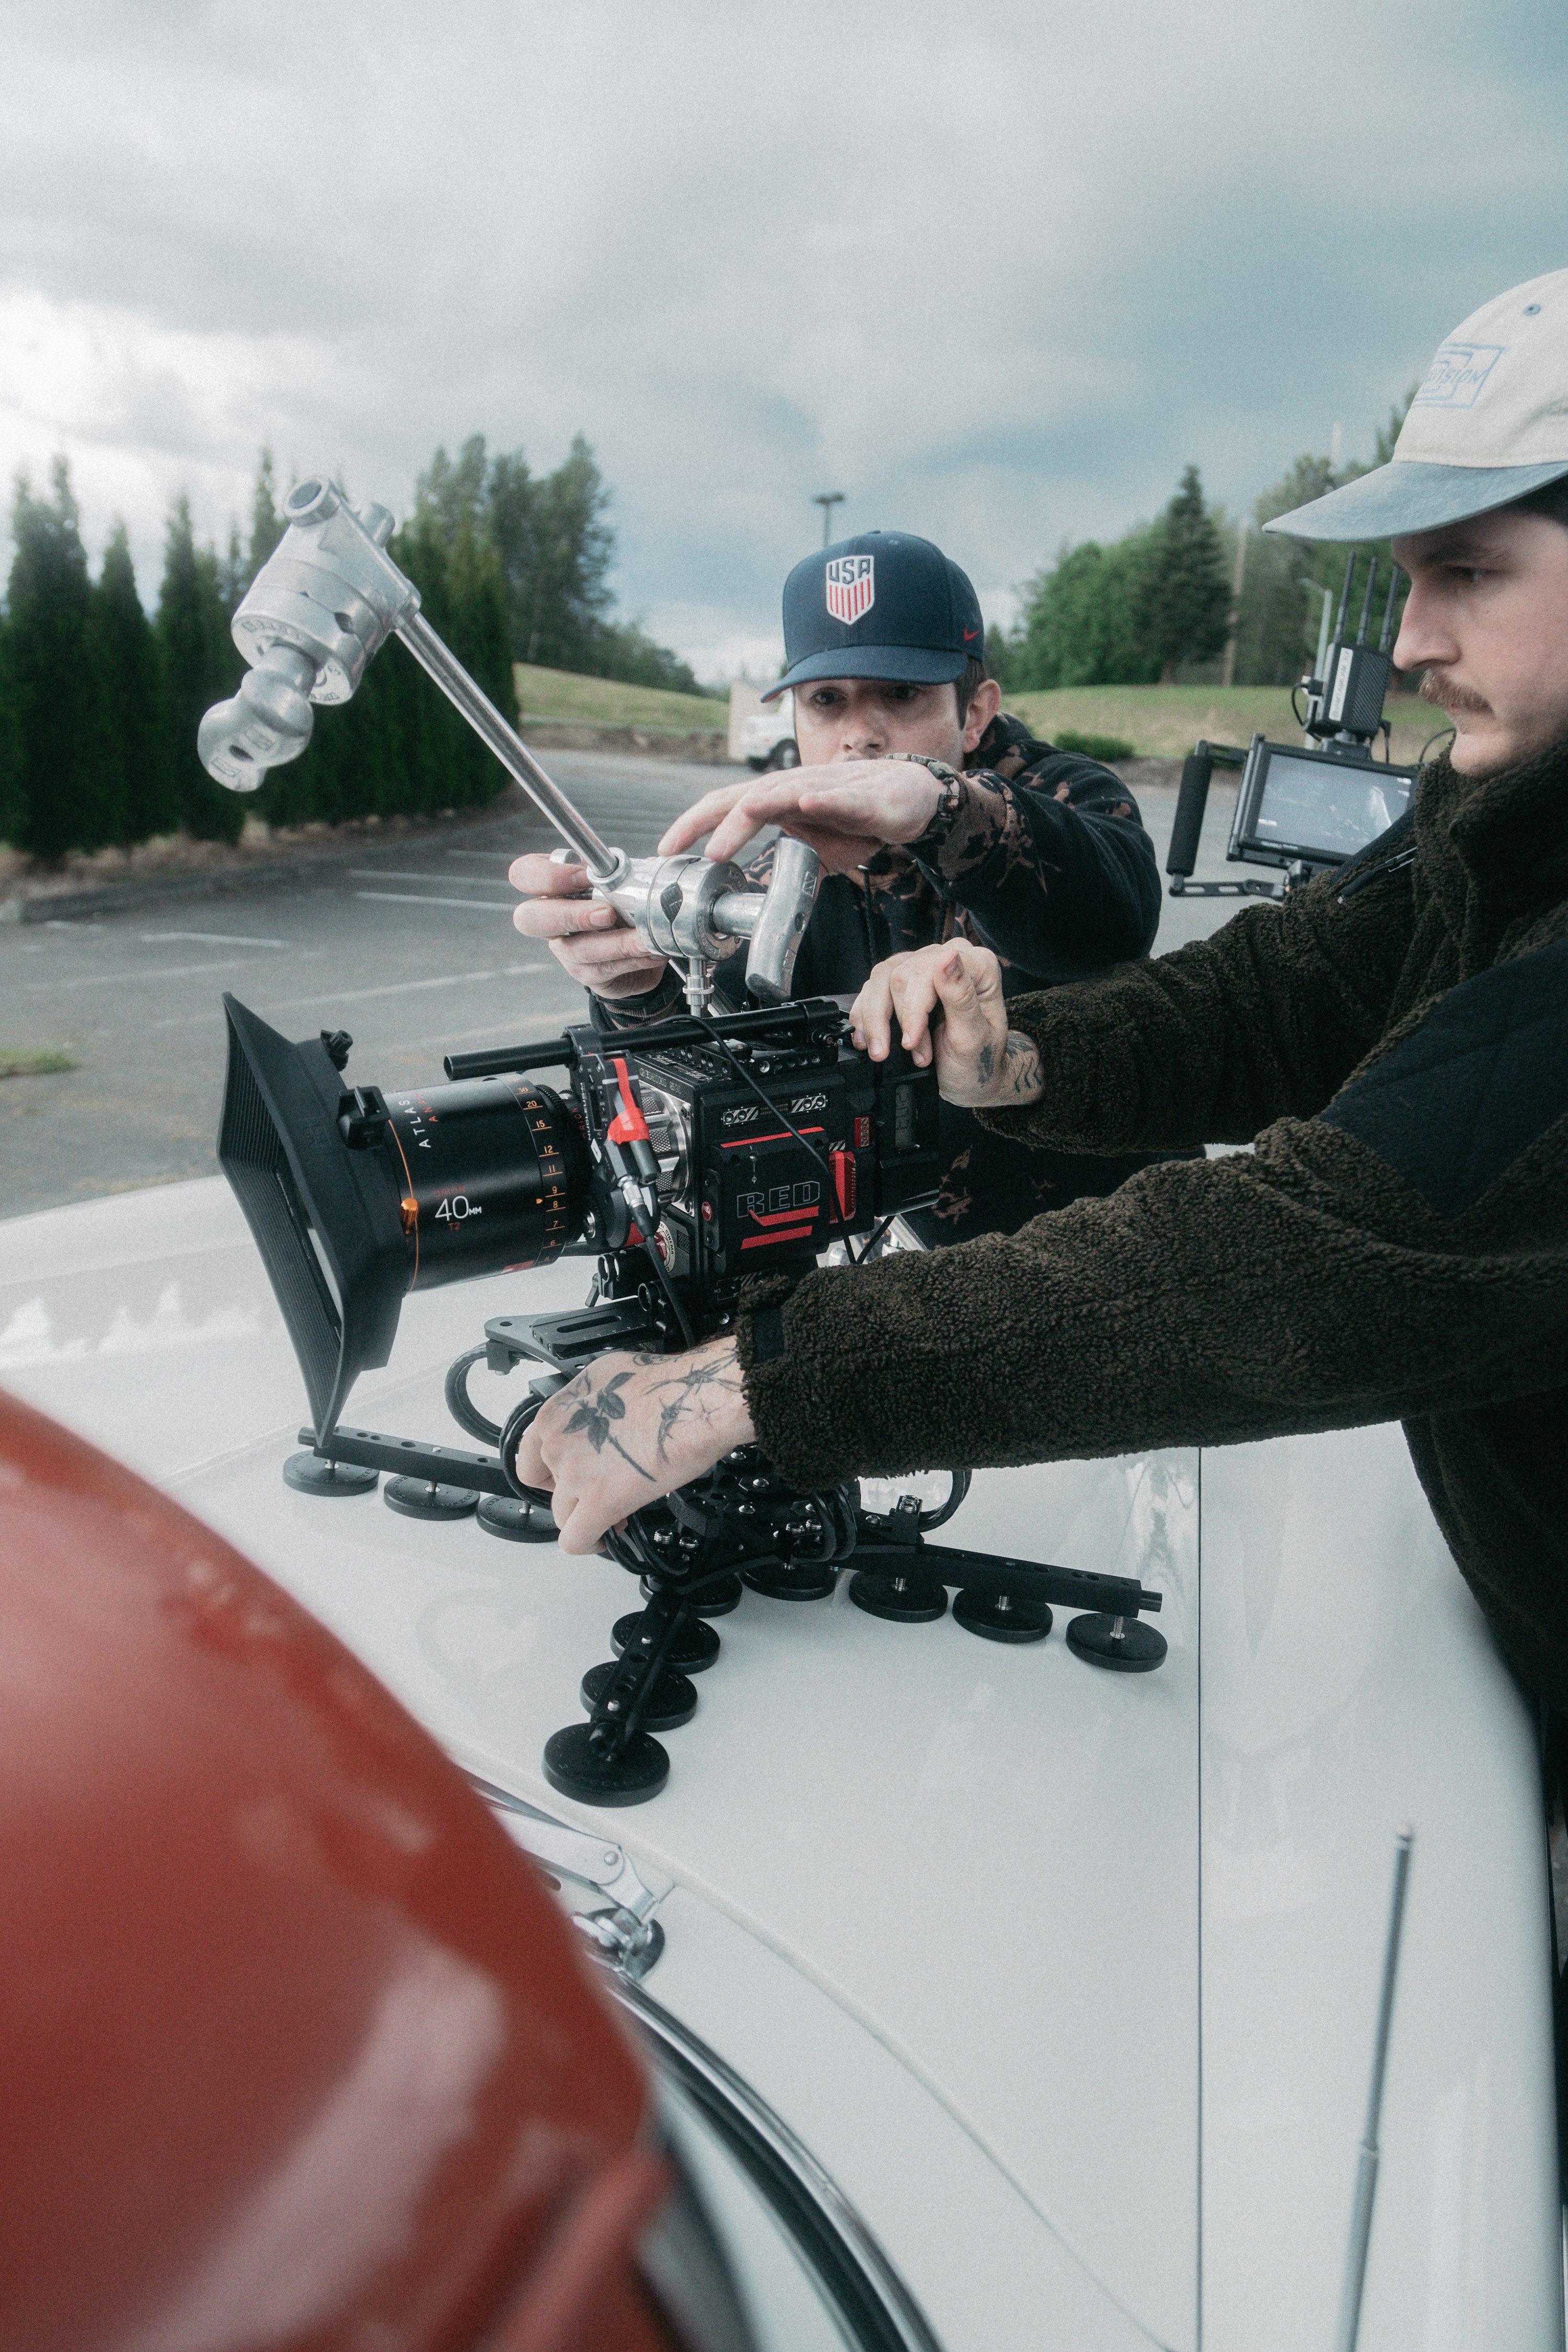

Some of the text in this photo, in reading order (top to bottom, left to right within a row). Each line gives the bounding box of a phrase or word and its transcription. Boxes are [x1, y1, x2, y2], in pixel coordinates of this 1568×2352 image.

[828, 558, 870, 584] USA
[398, 1100, 431, 1148] ATLAS
[536, 1120, 545, 1128] 15
[544, 1145, 553, 1154] 12
[548, 1164, 555, 1173] 11
[552, 1185, 557, 1194] 9
[736, 1180, 820, 1218] RED
[552, 1200, 558, 1208] 8
[448, 1222, 460, 1231] T2
